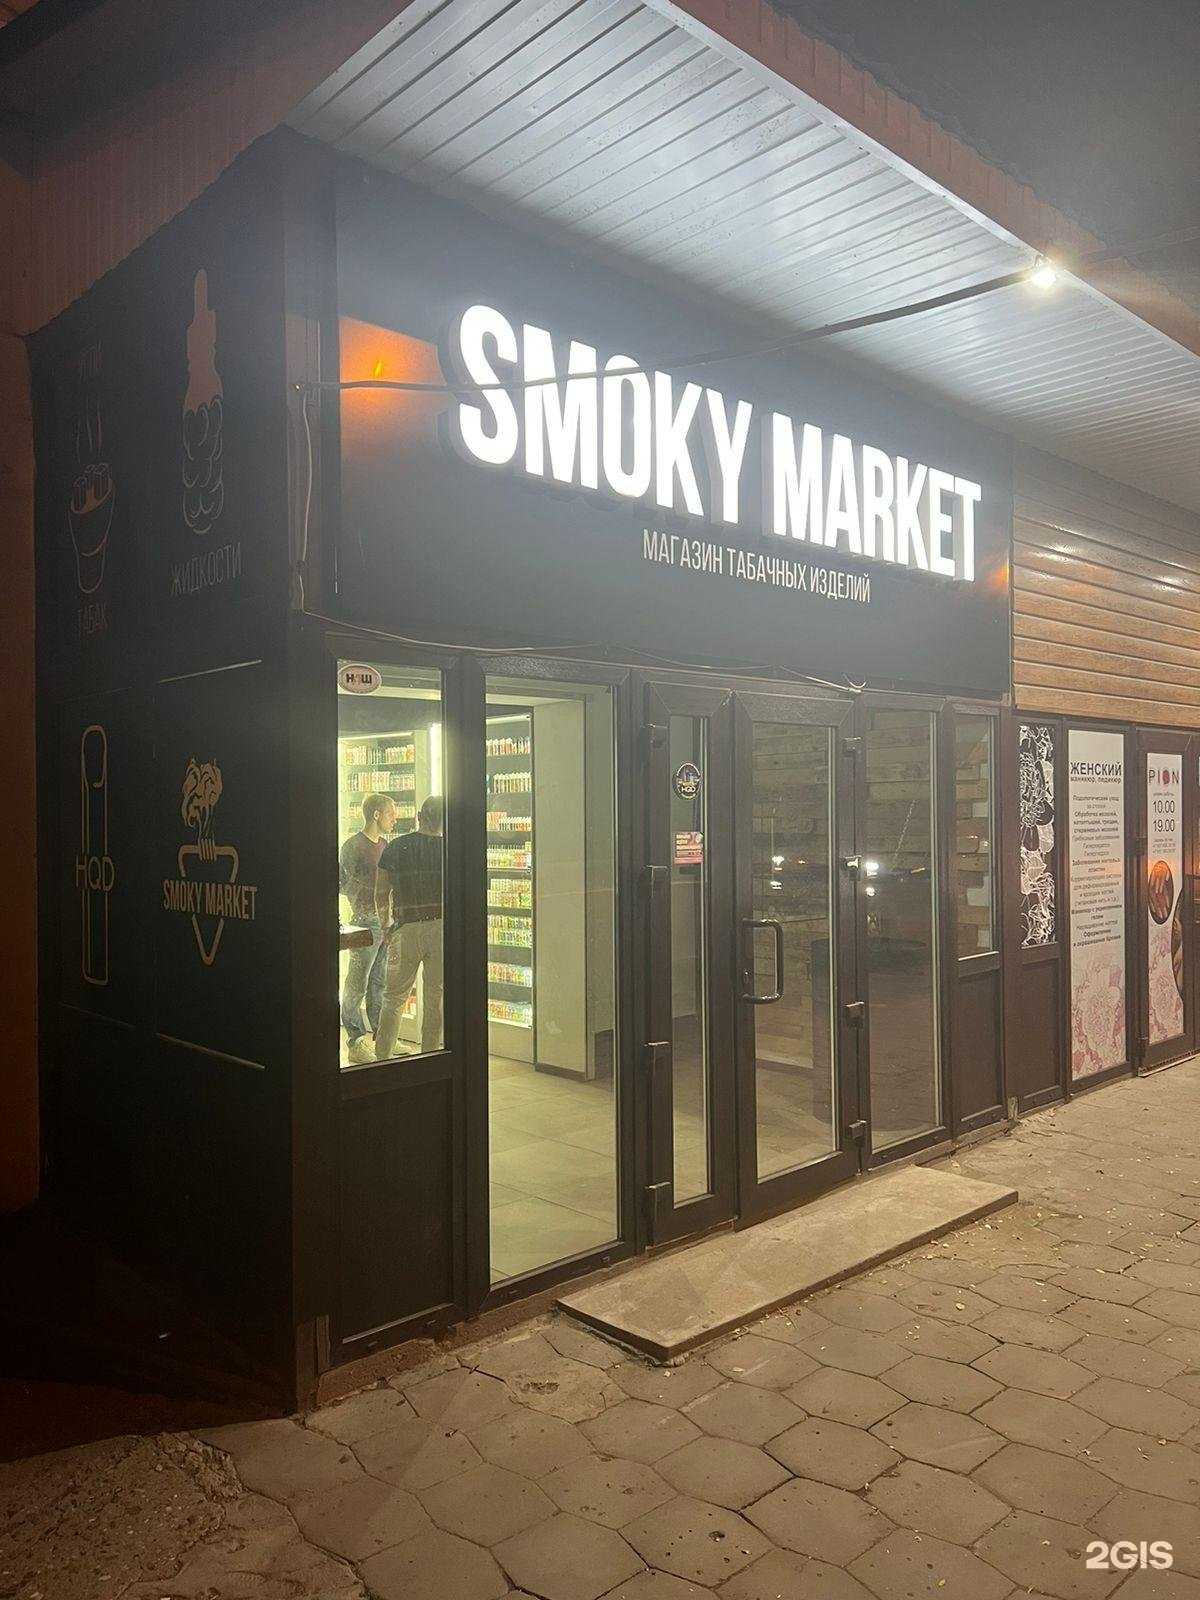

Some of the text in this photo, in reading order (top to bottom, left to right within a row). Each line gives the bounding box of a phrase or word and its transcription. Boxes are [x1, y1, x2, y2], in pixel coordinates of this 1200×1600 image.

[457, 304, 983, 583] SMOKY MARKET
[169, 542, 242, 597] ЖИДКОСТИ
[643, 528, 871, 603] МАГАЗИН ТАБАЧНЫХ ИЗДЕЛИЙ
[1070, 761, 1122, 776] ЖЕНСКИЙ
[1152, 799, 1175, 814] 10.00
[1152, 819, 1175, 833] 19.00
[75, 854, 116, 892] HQD
[161, 878, 258, 921] SMOKY MARKET
